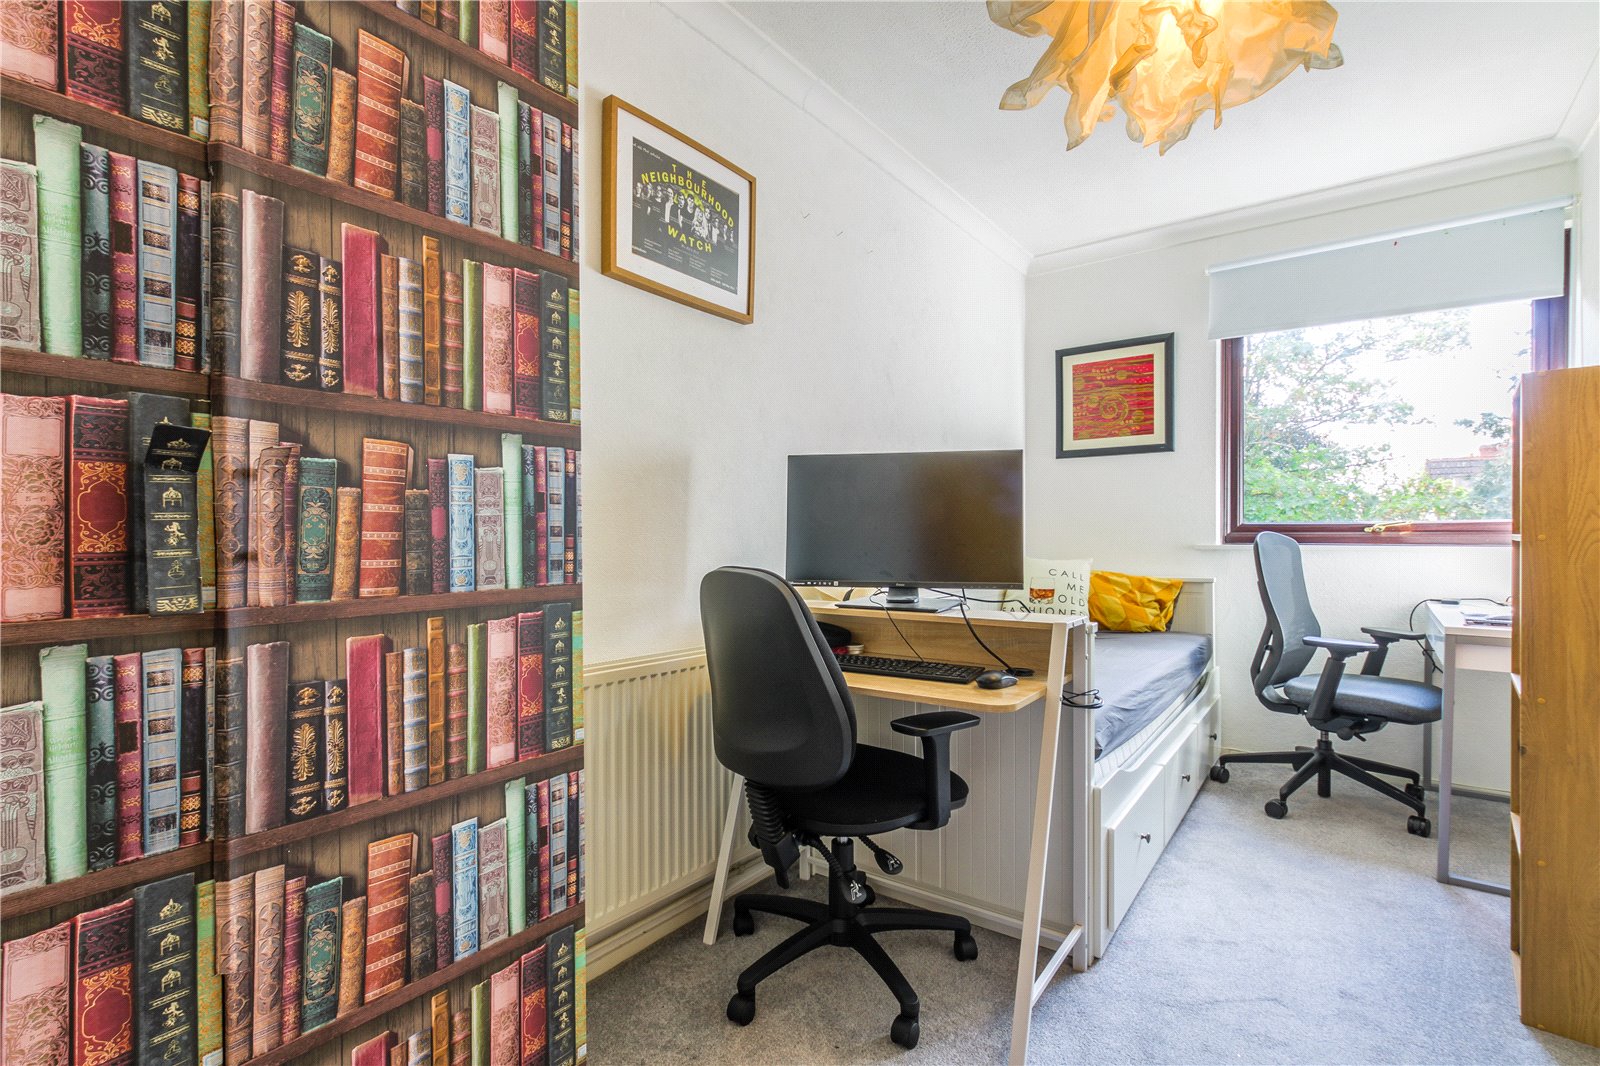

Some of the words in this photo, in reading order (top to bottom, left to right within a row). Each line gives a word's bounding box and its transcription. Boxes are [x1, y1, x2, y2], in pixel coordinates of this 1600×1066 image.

[672, 164, 707, 188] THE
[641, 172, 734, 229] NEIGHBOURHOOD
[667, 224, 713, 253] WATCH
[1048, 568, 1084, 581] CALL
[1066, 583, 1084, 594] ME
[1057, 594, 1086, 607] OLD
